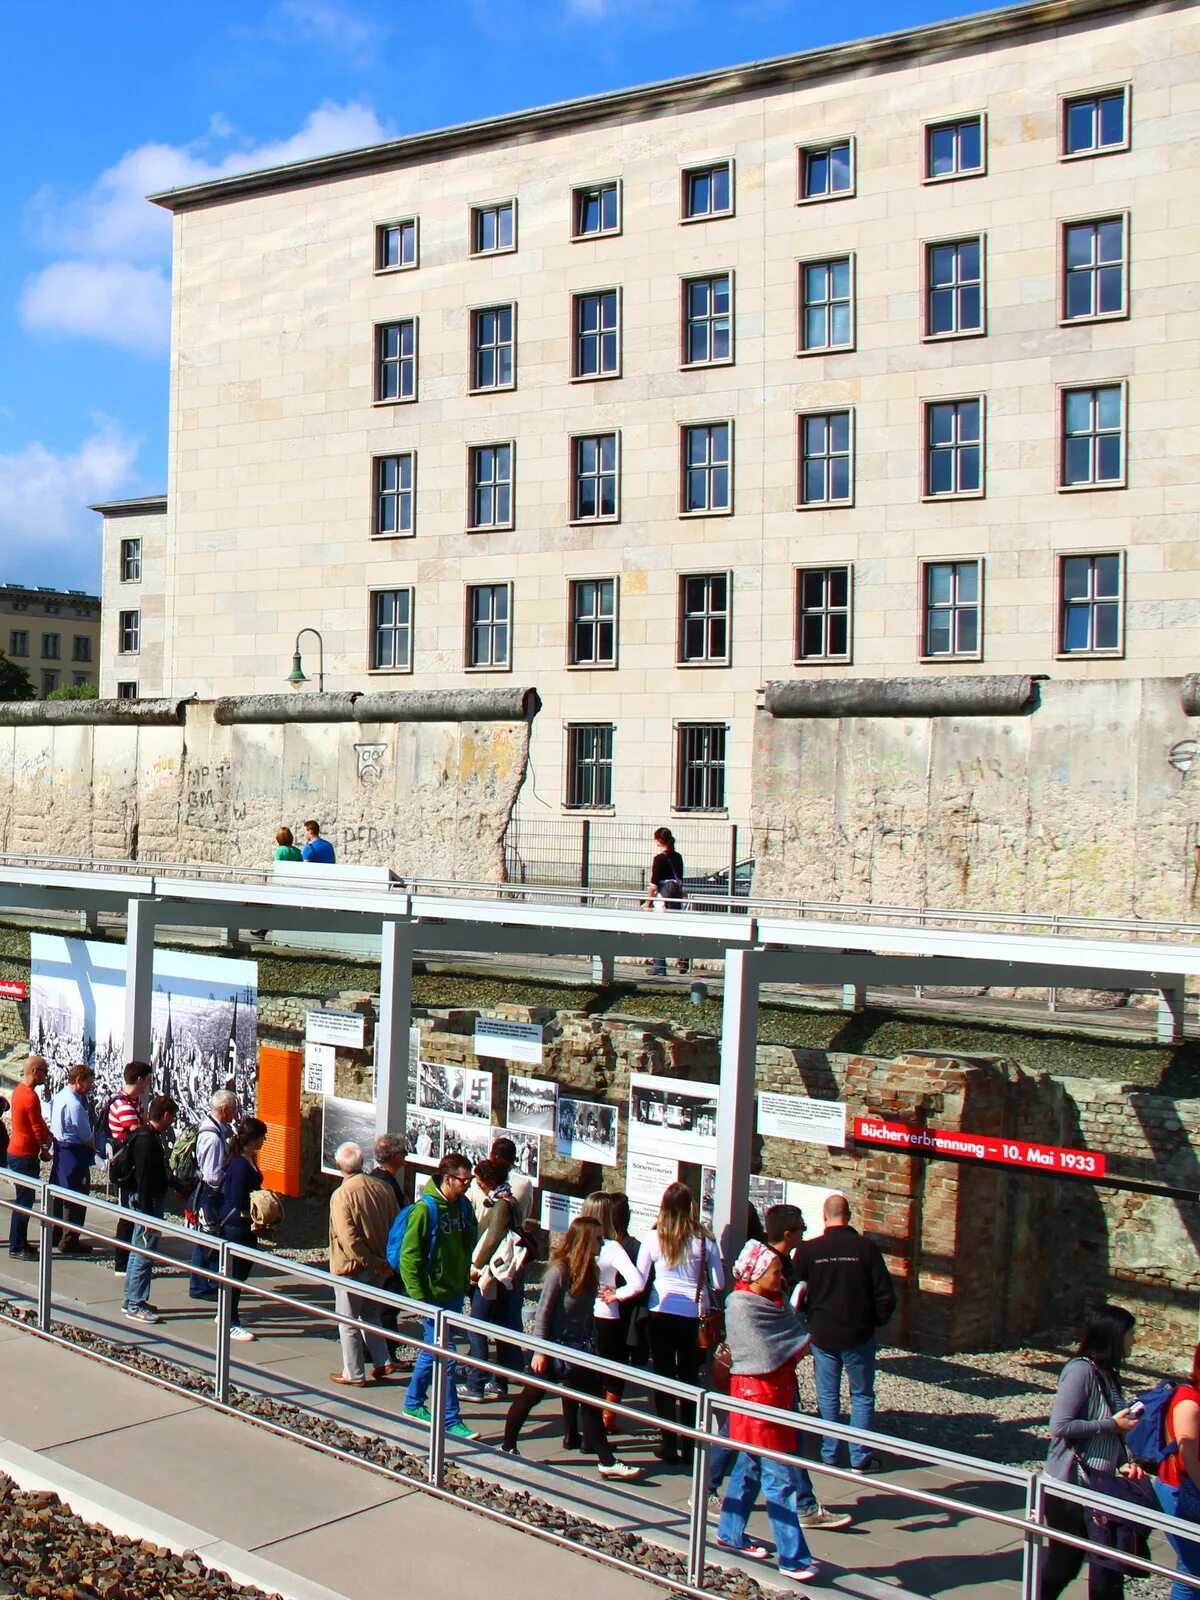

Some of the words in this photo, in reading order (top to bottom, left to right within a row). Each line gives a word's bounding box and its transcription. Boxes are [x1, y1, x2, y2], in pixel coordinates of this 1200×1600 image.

[861, 1123, 985, 1158] Bücherverbrennung
[1002, 1144, 1023, 1161] 10.
[1026, 1148, 1055, 1166] Mai
[1060, 1153, 1096, 1172] 1933
